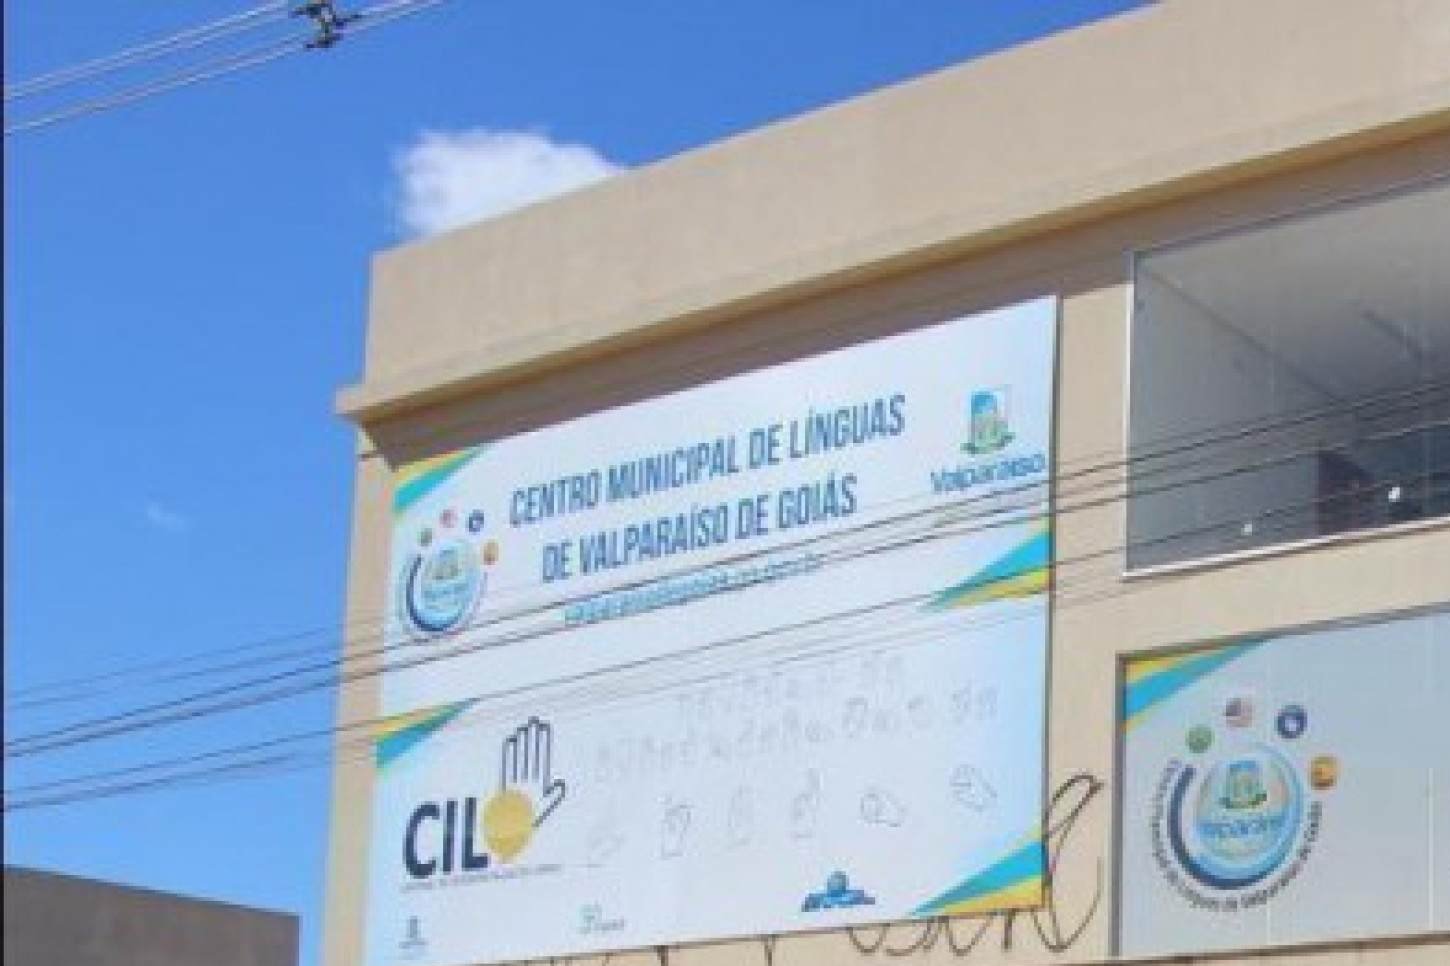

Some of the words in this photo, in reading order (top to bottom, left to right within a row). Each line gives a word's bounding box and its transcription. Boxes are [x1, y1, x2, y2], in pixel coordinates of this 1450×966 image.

[510, 467, 600, 528] CENTRO
[606, 433, 740, 503] MUNICIPAL
[749, 423, 784, 470] DE
[790, 392, 906, 460] LÍNGUAS
[541, 540, 574, 584] DE
[579, 500, 730, 575] VALPARAÍSO
[735, 492, 770, 540] DE
[777, 470, 859, 530] GOIÁS
